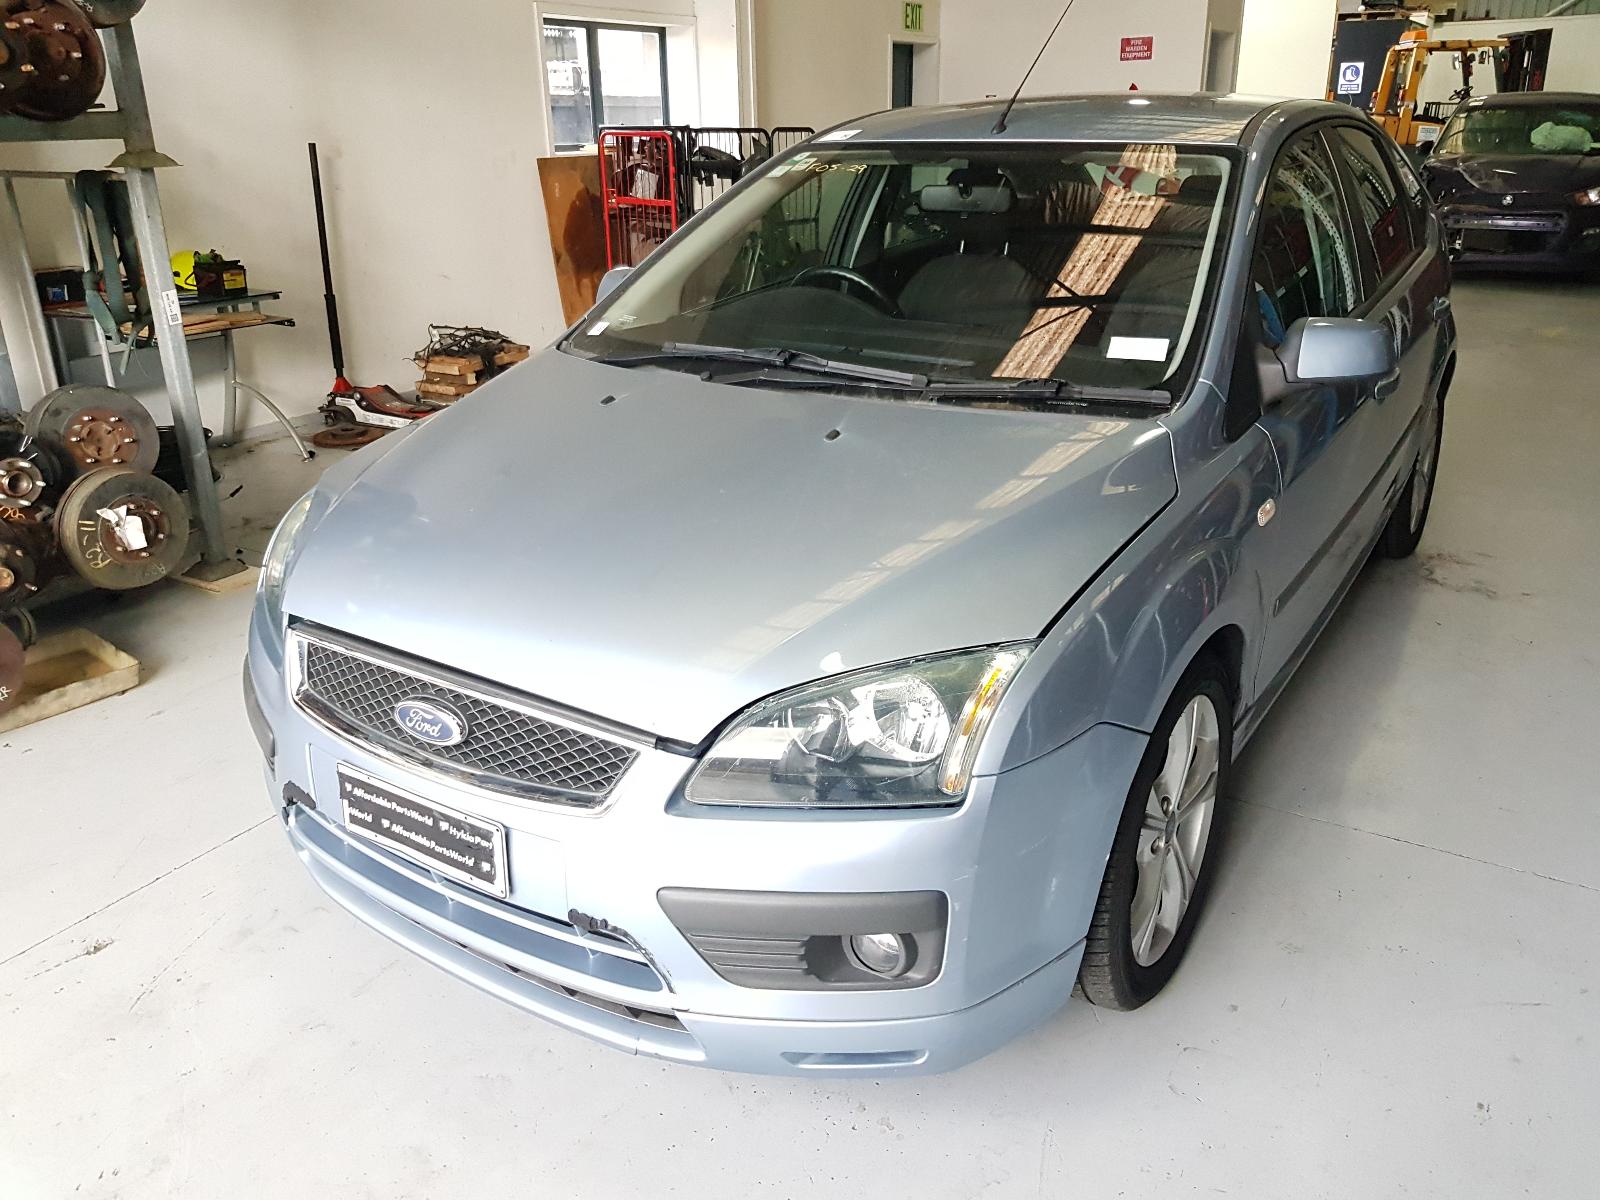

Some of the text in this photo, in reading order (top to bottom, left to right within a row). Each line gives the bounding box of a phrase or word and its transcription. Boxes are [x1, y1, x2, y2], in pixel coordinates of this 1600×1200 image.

[905, 3, 922, 30] EXIT
[1121, 51, 1151, 59] EQUIPMENT
[406, 708, 443, 737] Ford
